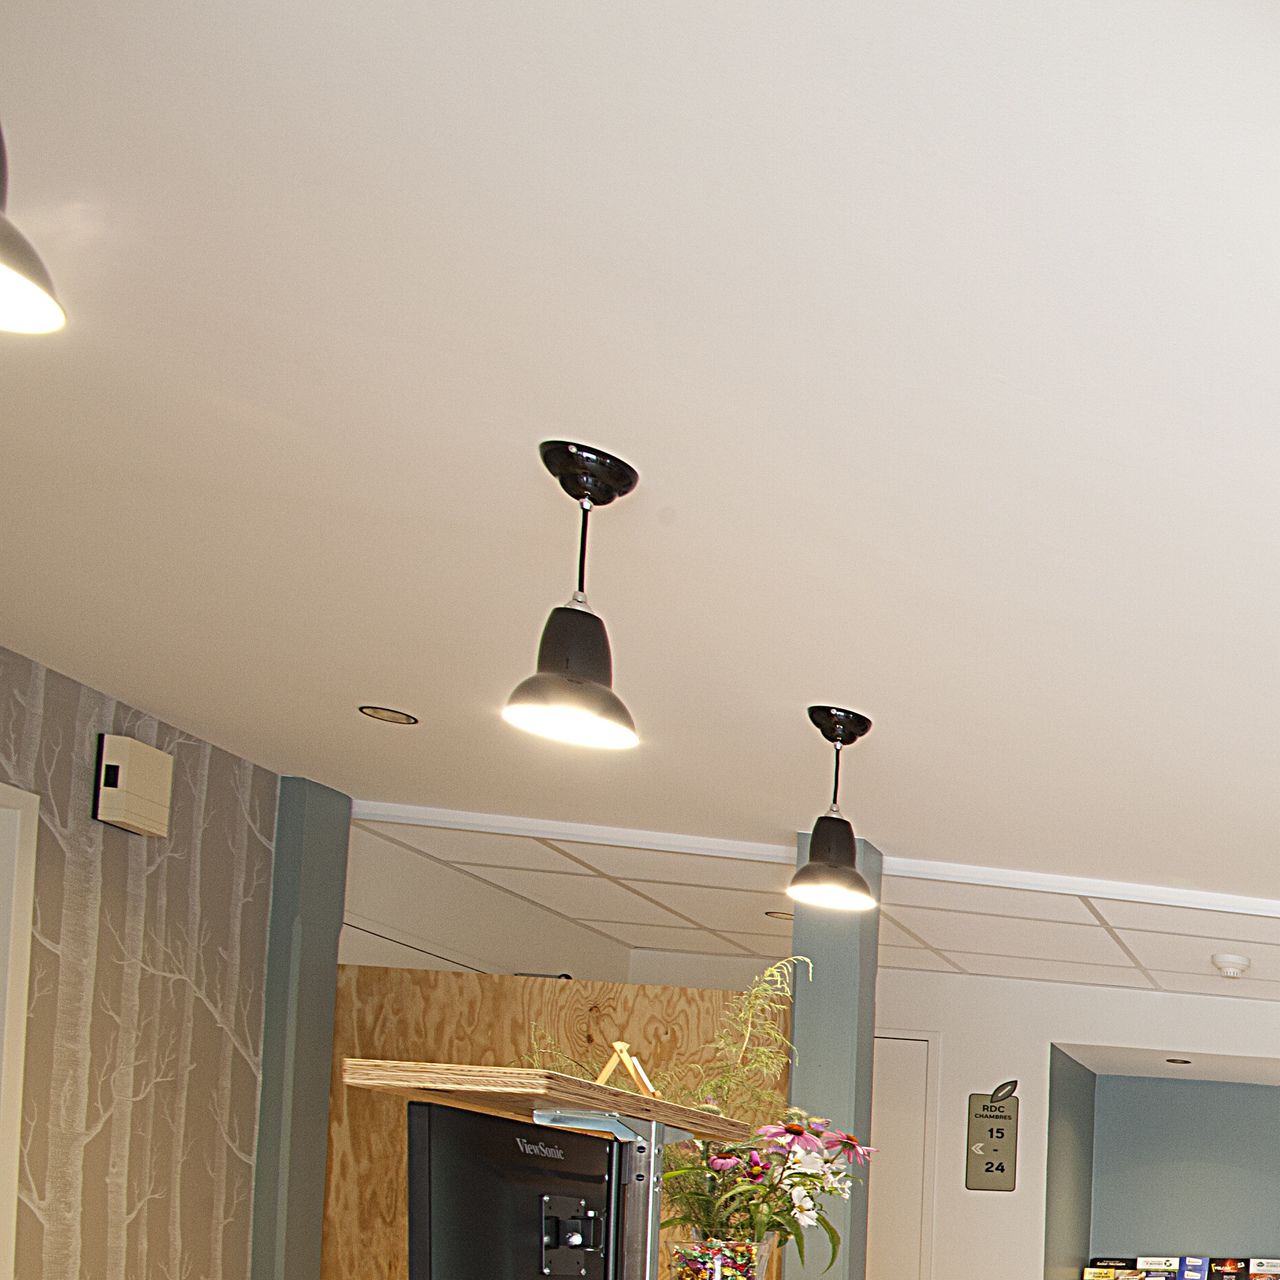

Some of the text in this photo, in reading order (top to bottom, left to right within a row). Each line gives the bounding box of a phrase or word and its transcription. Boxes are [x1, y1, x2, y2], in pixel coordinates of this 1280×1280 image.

[982, 1104, 1005, 1113] RDC
[974, 1113, 1012, 1121] CHAMBRES
[988, 1127, 1005, 1139] 15
[515, 1137, 565, 1160] ViewSonic
[984, 1161, 1005, 1173] 24
